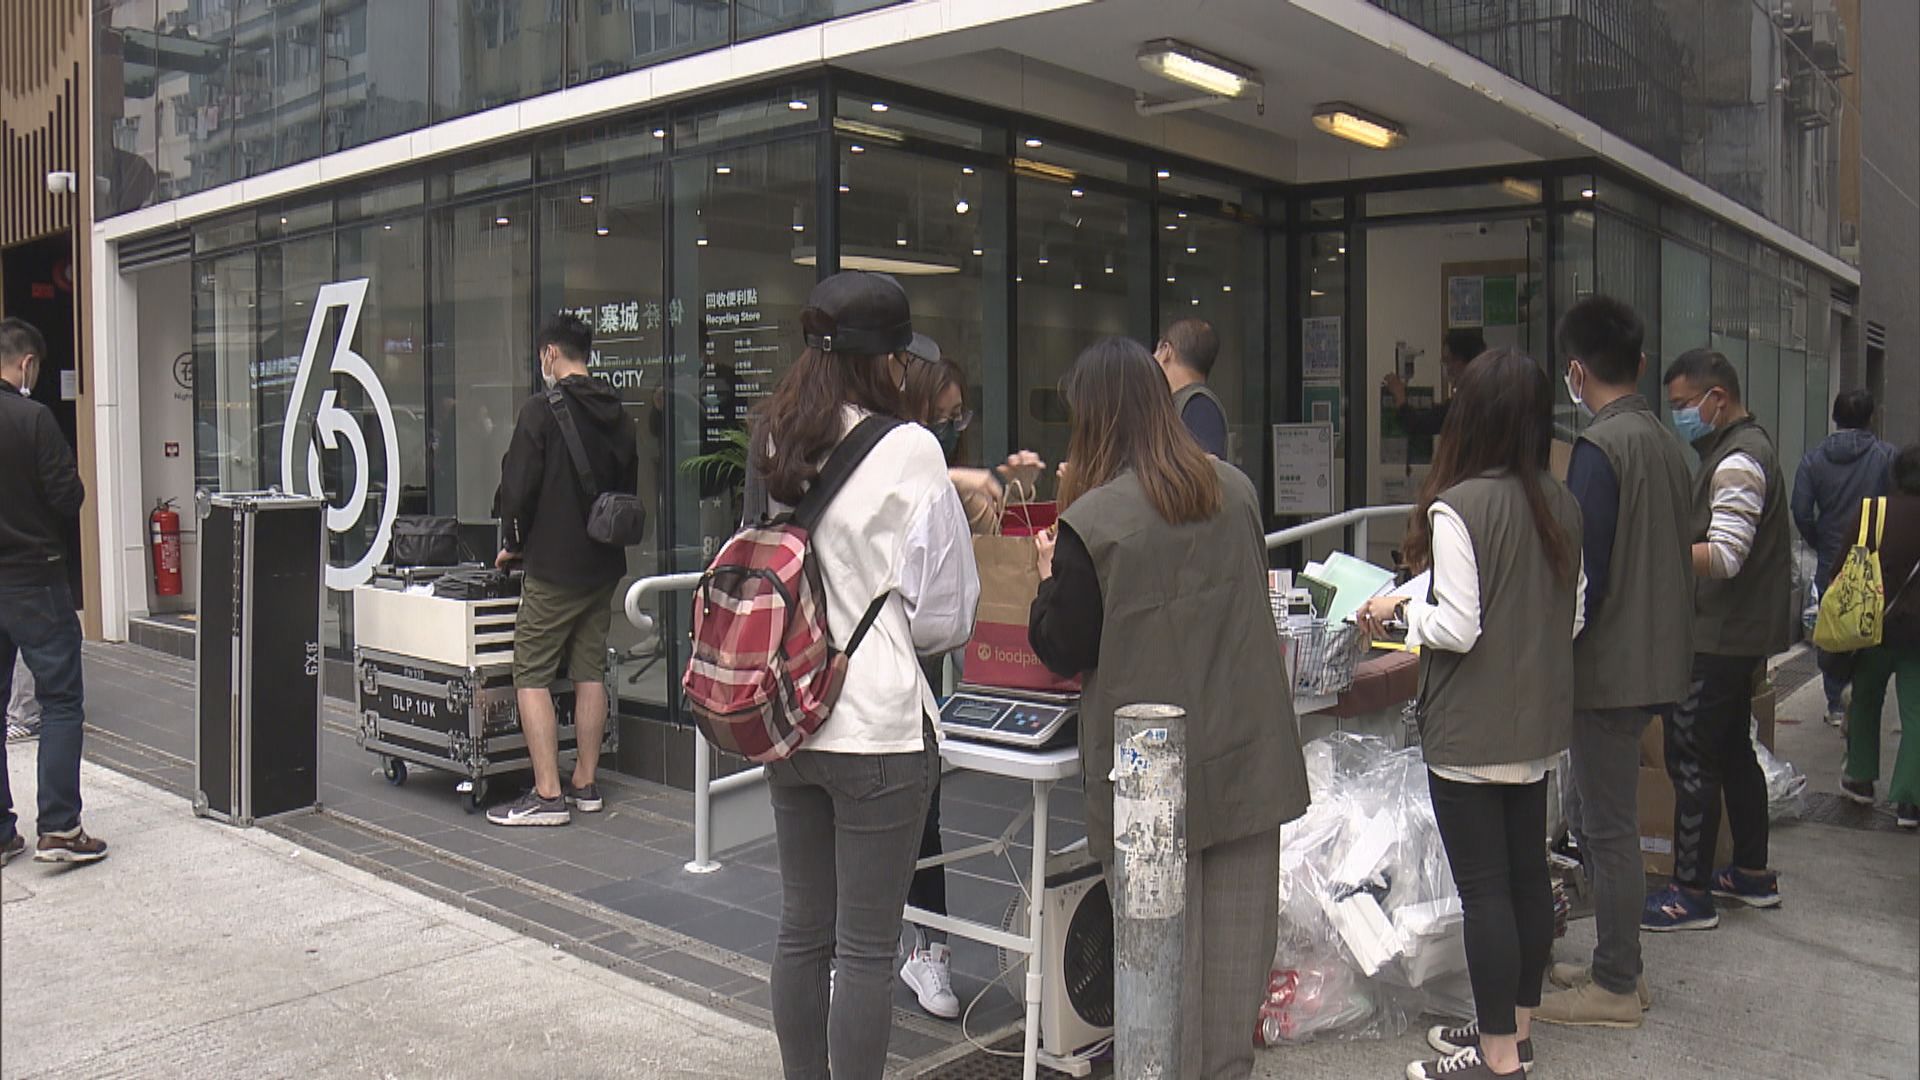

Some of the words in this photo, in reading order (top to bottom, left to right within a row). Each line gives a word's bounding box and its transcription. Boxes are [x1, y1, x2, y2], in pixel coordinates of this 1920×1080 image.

[706, 288, 757, 309] 回收便利點
[706, 312, 740, 326] Recycling
[740, 311, 760, 322] Store
[612, 370, 643, 388] CITY
[392, 693, 412, 712] DLP
[416, 699, 436, 718] 10K
